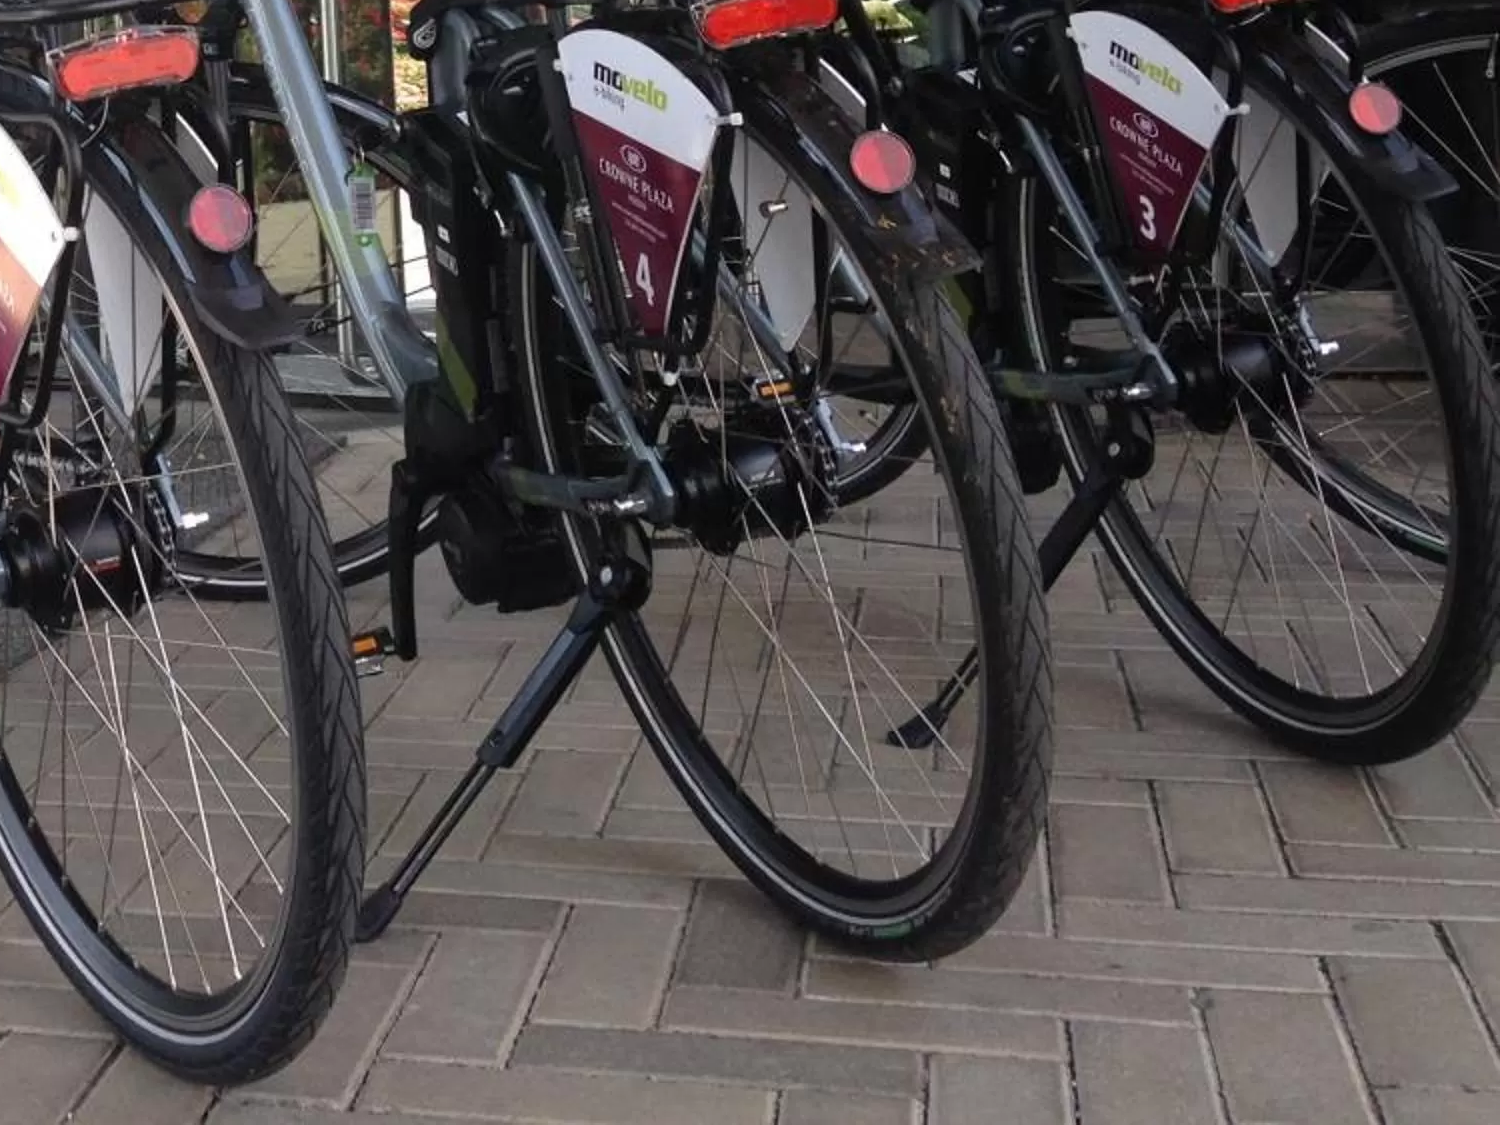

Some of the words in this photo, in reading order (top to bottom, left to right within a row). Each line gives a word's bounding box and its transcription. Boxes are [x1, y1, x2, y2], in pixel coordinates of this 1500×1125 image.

[594, 61, 668, 112] movelo
[1109, 40, 1182, 95] movelo
[1151, 143, 1183, 179] PLAZA
[641, 180, 675, 214] PLAZA
[1139, 194, 1157, 240] 3
[635, 252, 655, 307] 4
